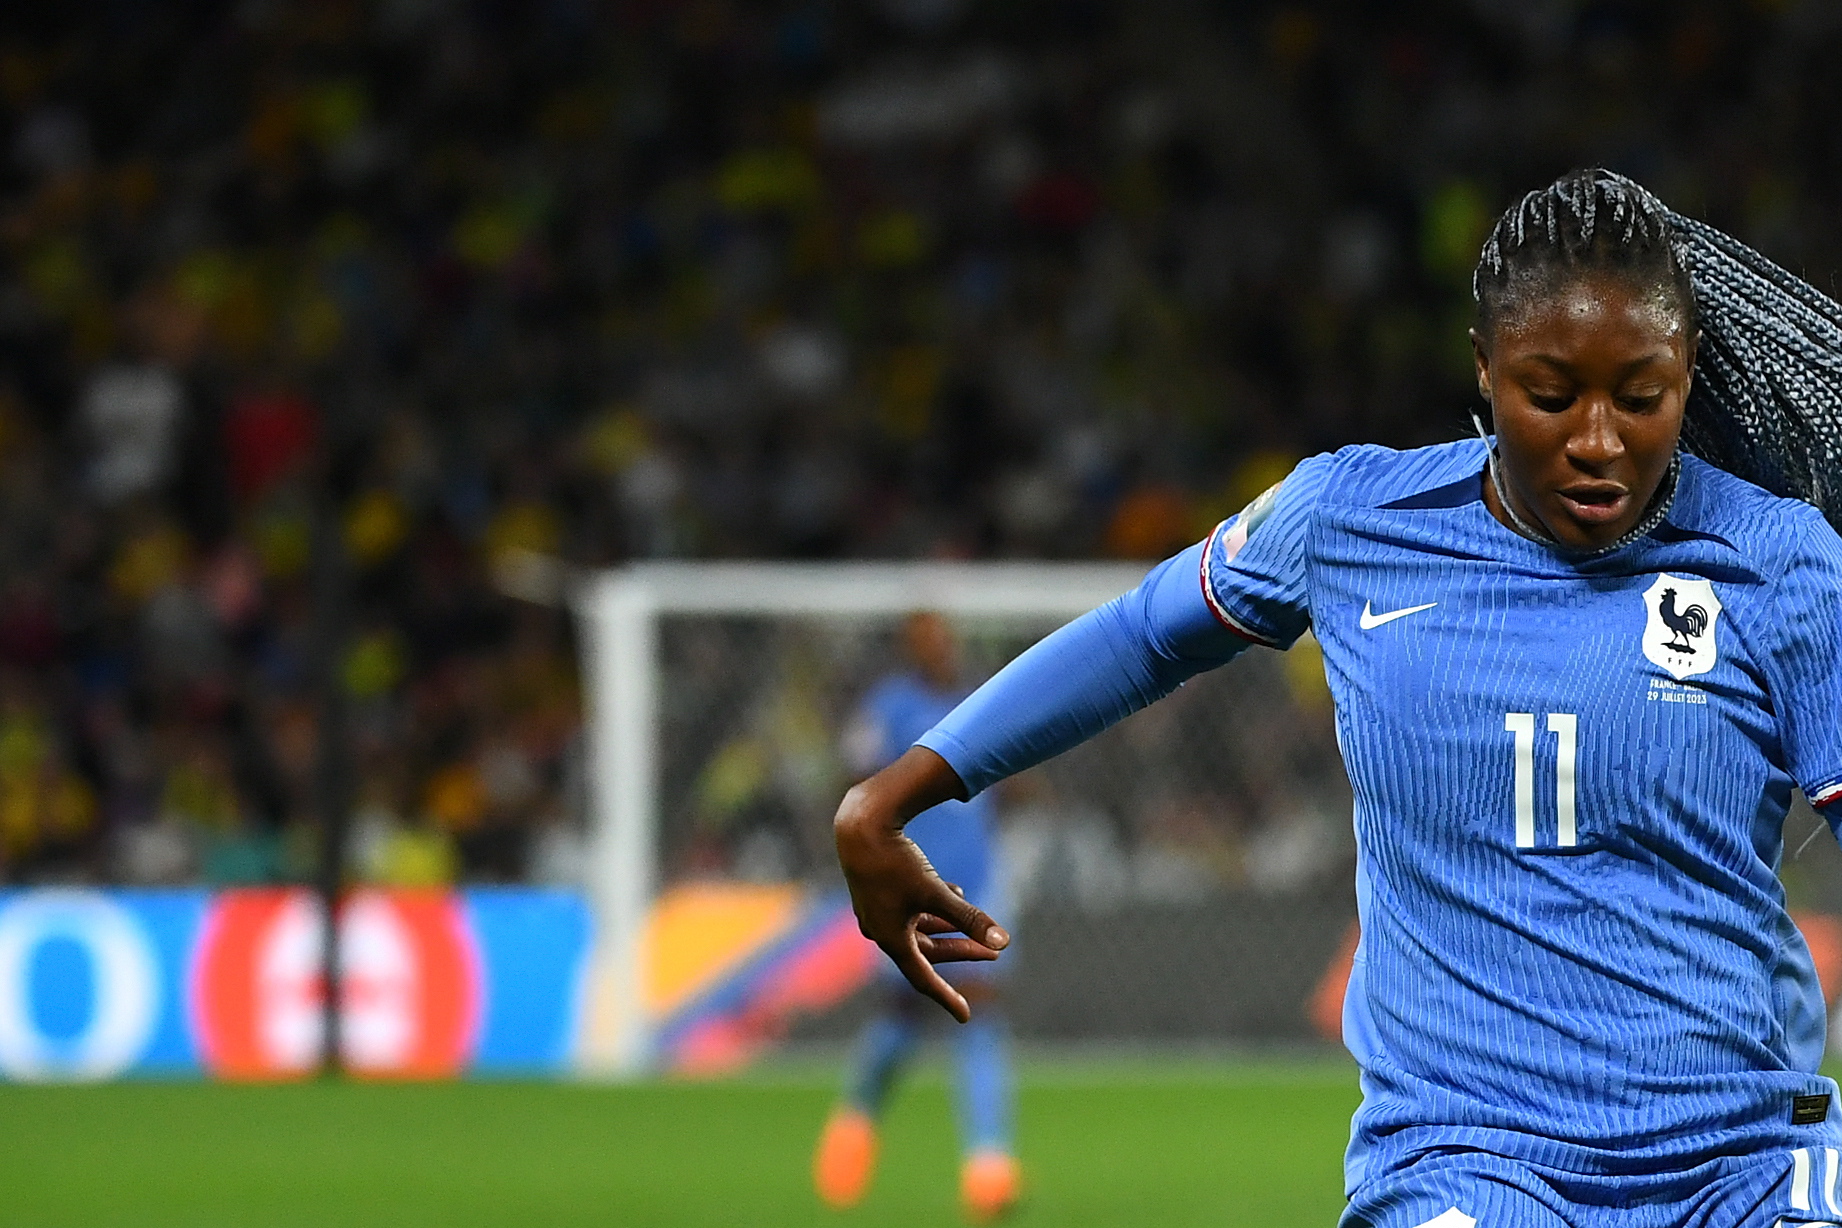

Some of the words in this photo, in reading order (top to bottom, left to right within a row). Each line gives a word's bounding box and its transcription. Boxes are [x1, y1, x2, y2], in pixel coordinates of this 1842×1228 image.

[1647, 691, 1658, 701] 29
[1661, 692, 1684, 702] JUILLET
[1687, 694, 1707, 704] 2023
[1504, 712, 1578, 848] 11
